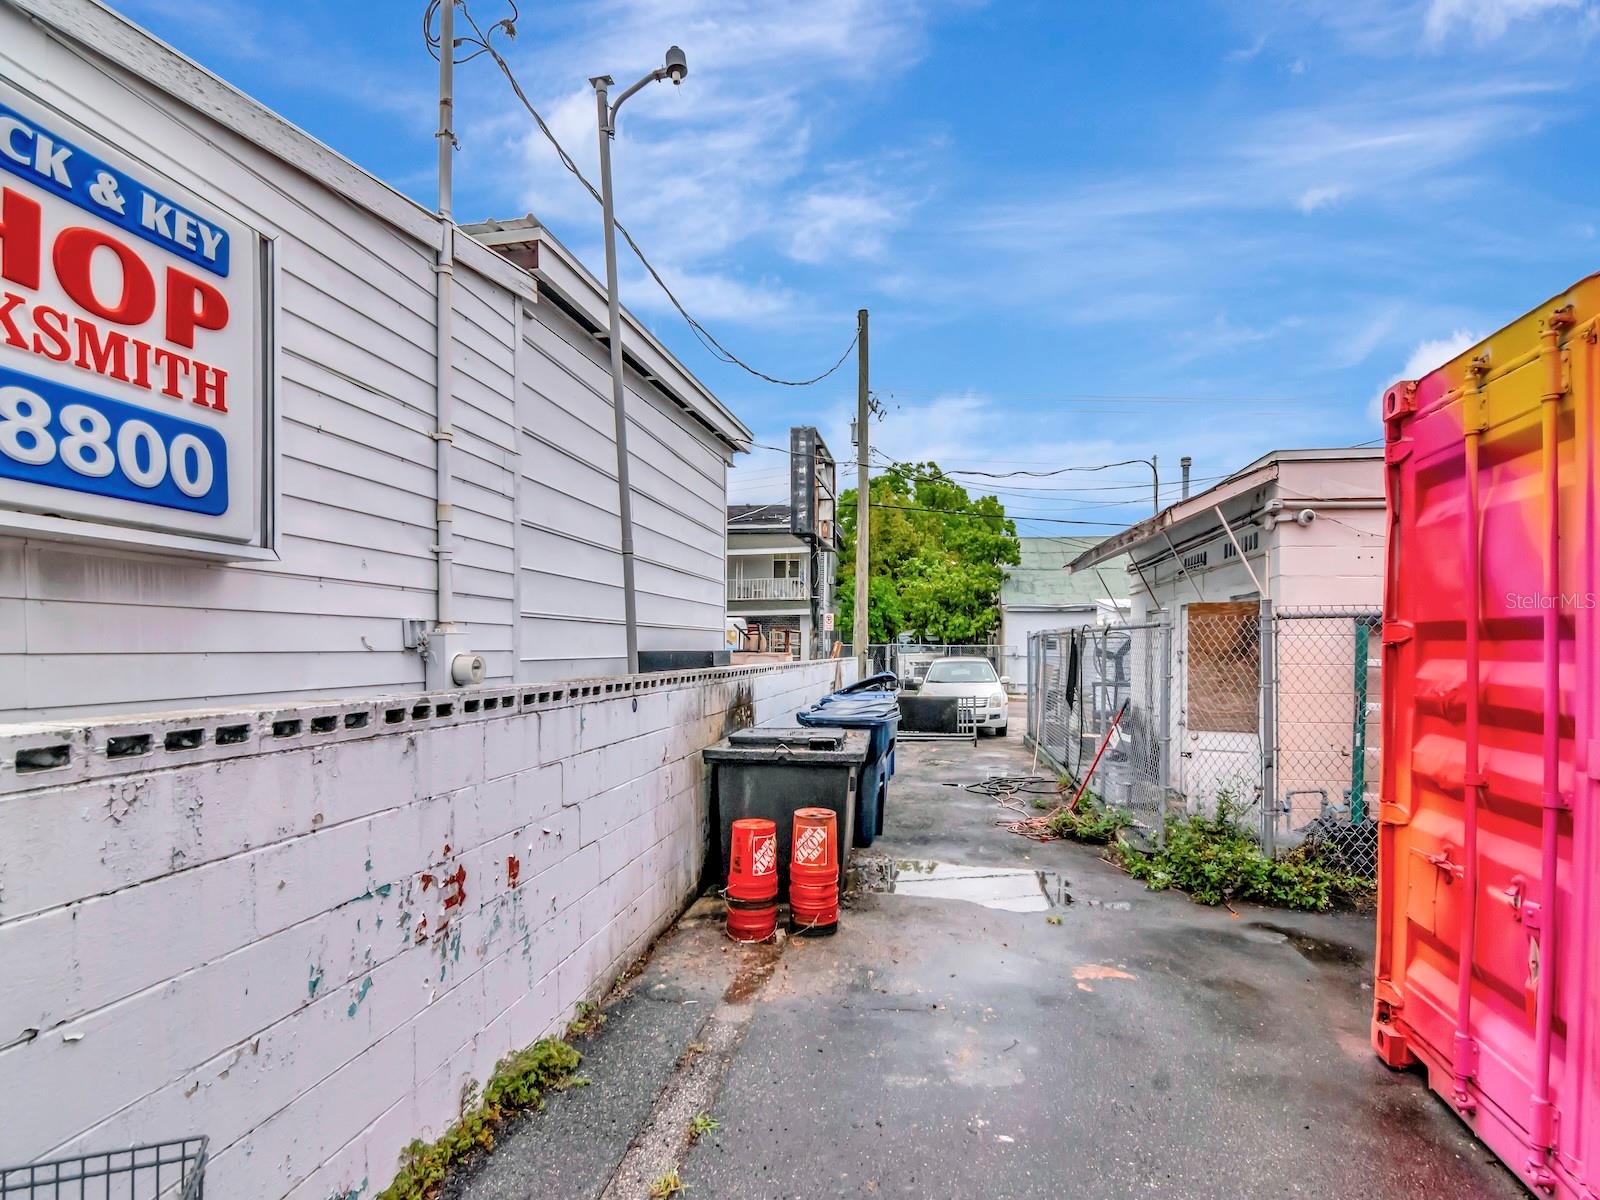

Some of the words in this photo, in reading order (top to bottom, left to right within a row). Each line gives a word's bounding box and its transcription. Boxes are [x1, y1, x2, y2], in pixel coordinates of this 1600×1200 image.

[0, 116, 73, 190] CK
[88, 171, 126, 216] &
[141, 191, 223, 263] KEY
[0, 385, 214, 498] 8800
